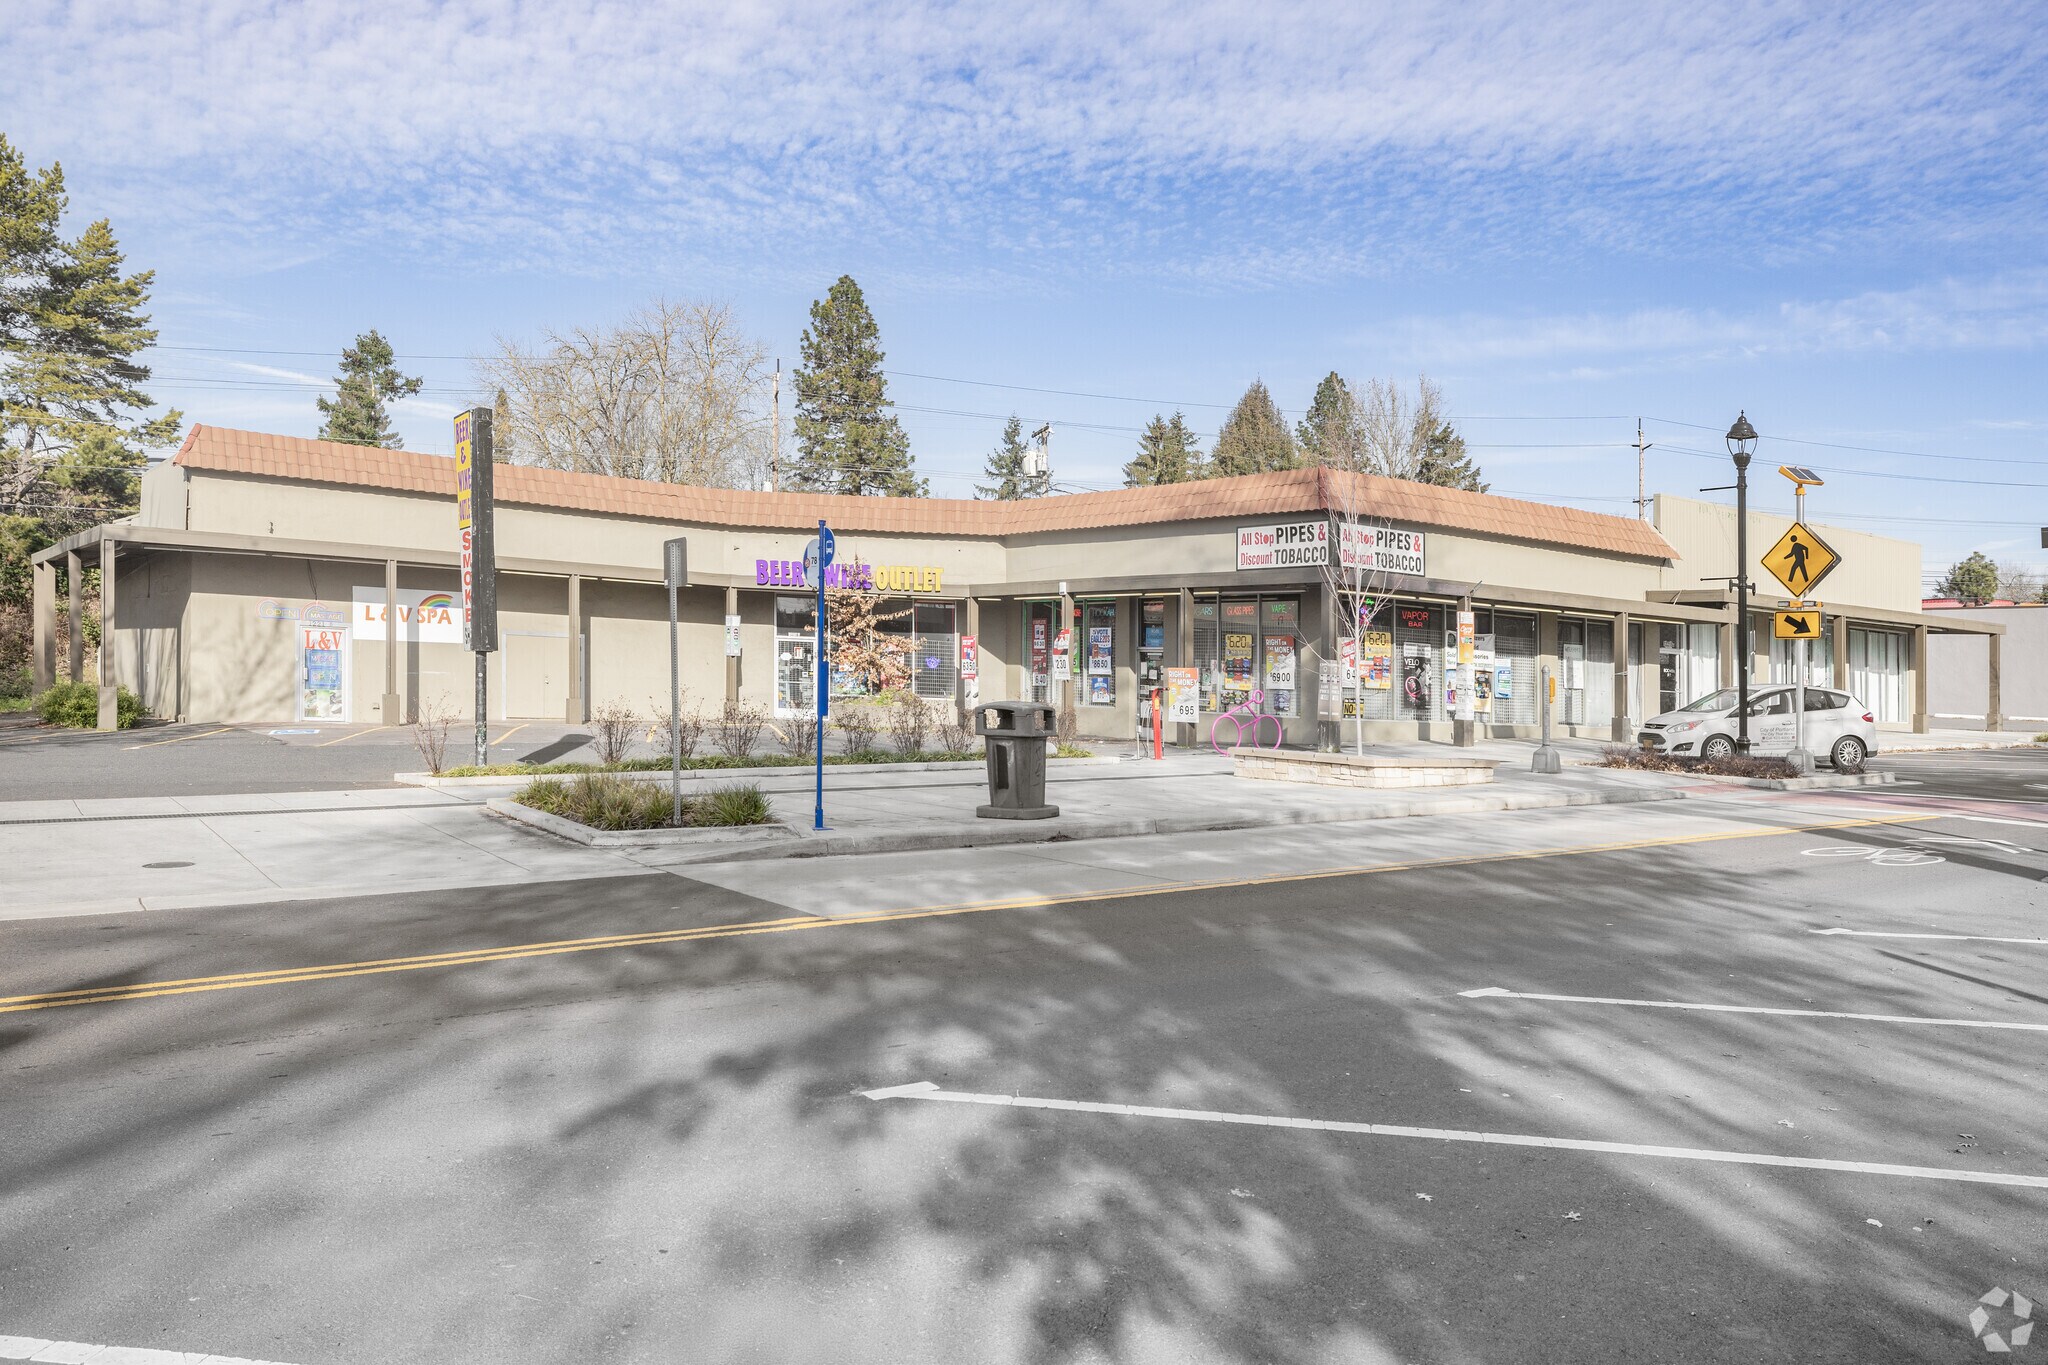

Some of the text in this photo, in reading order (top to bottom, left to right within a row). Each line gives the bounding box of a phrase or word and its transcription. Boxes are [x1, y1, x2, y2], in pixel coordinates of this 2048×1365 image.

[455, 417, 470, 445] BEER
[460, 446, 467, 465] &
[457, 467, 472, 493] WINE
[1241, 523, 1326, 547] All Stop PIPES &
[1376, 530, 1411, 551] PIPES
[1413, 535, 1421, 553] &
[811, 556, 818, 565] 78
[1240, 546, 1327, 566] Discount TOBACCO
[1342, 549, 1422, 572] Disunt TOBACCO
[462, 530, 472, 623] SMOKE
[756, 559, 945, 593] BEER WINE OUTLET
[365, 605, 376, 622] L
[398, 607, 413, 623] V
[417, 608, 453, 625] SPA
[1226, 606, 1242, 617] GLASS
[1271, 603, 1286, 613] VAPE
[1401, 610, 1430, 622] VAPOR
[1404, 658, 1420, 666] VELO
[1168, 670, 1185, 678] RIGHT
[1177, 678, 1198, 687] MONEY
